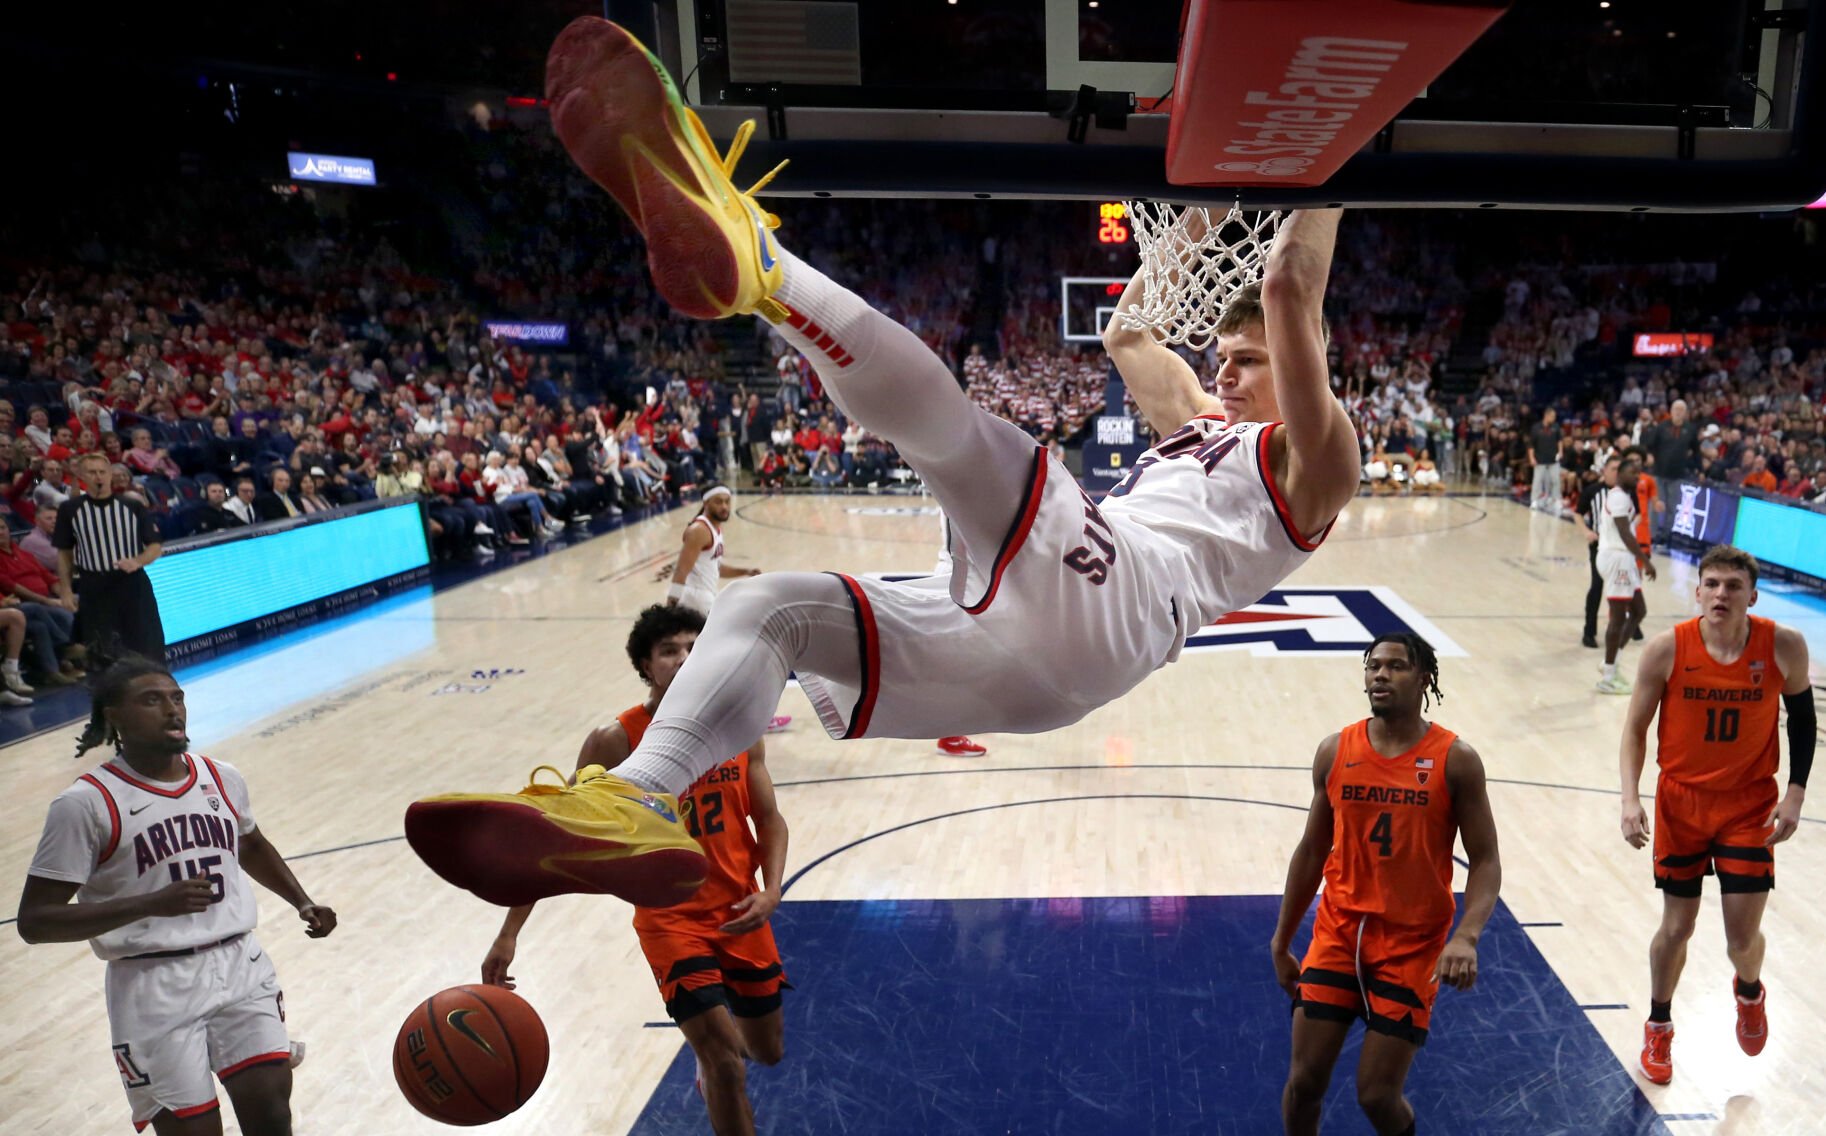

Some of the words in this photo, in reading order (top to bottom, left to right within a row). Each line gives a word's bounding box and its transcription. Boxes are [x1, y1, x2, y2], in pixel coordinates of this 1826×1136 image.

[1099, 218, 1128, 242] 26
[1097, 431, 1134, 445] PROTEIN
[1682, 686, 1763, 701] BEAVERS
[1704, 708, 1739, 742] 10
[1341, 785, 1429, 806] BEAVERS
[684, 790, 724, 838] 12
[133, 813, 235, 878] ARIZONA
[1368, 812, 1392, 857] 4
[407, 1026, 455, 1104] ELITE
